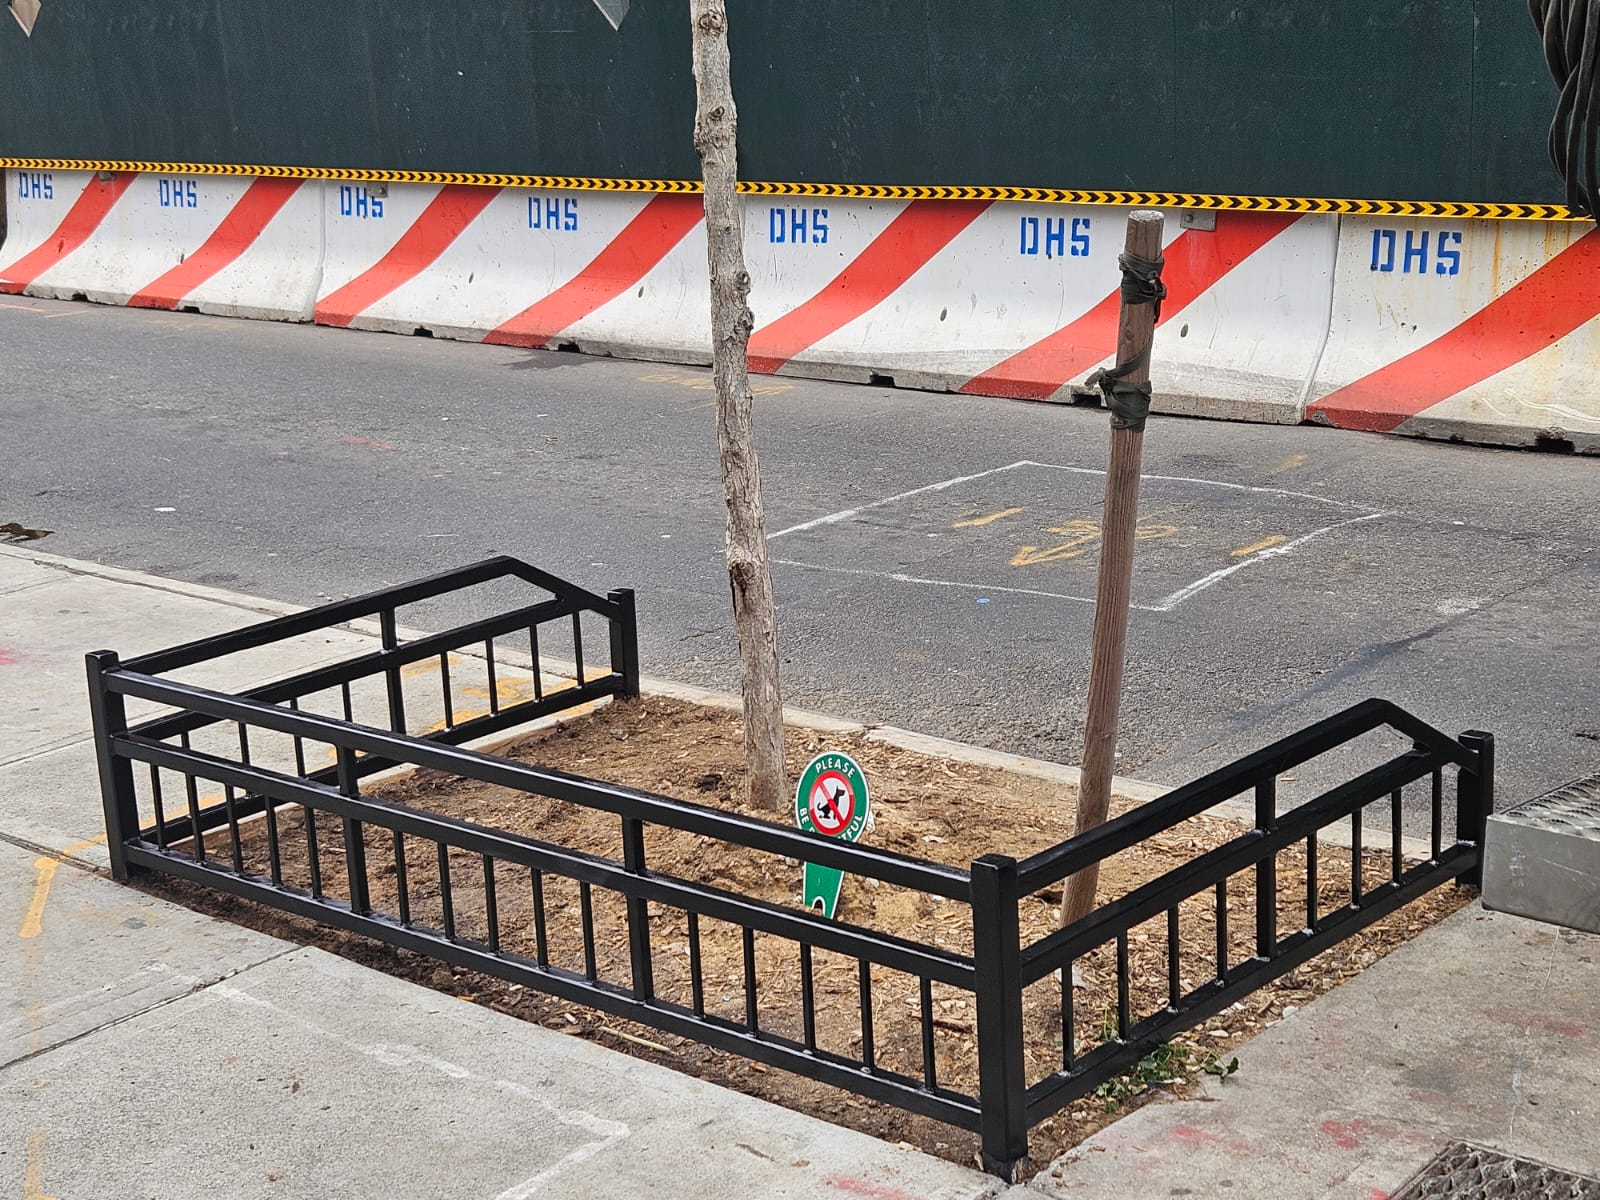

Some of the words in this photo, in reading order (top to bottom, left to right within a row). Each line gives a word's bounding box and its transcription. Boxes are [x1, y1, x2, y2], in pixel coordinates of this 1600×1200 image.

[20, 172, 53, 199] DHS
[160, 180, 197, 208] DHS
[529, 197, 578, 231] DHS
[770, 209, 829, 243] DHS
[1021, 216, 1091, 256] DHS
[1371, 229, 1462, 275] DHS
[816, 758, 855, 777] PLEASE
[800, 808, 809, 824] BE
